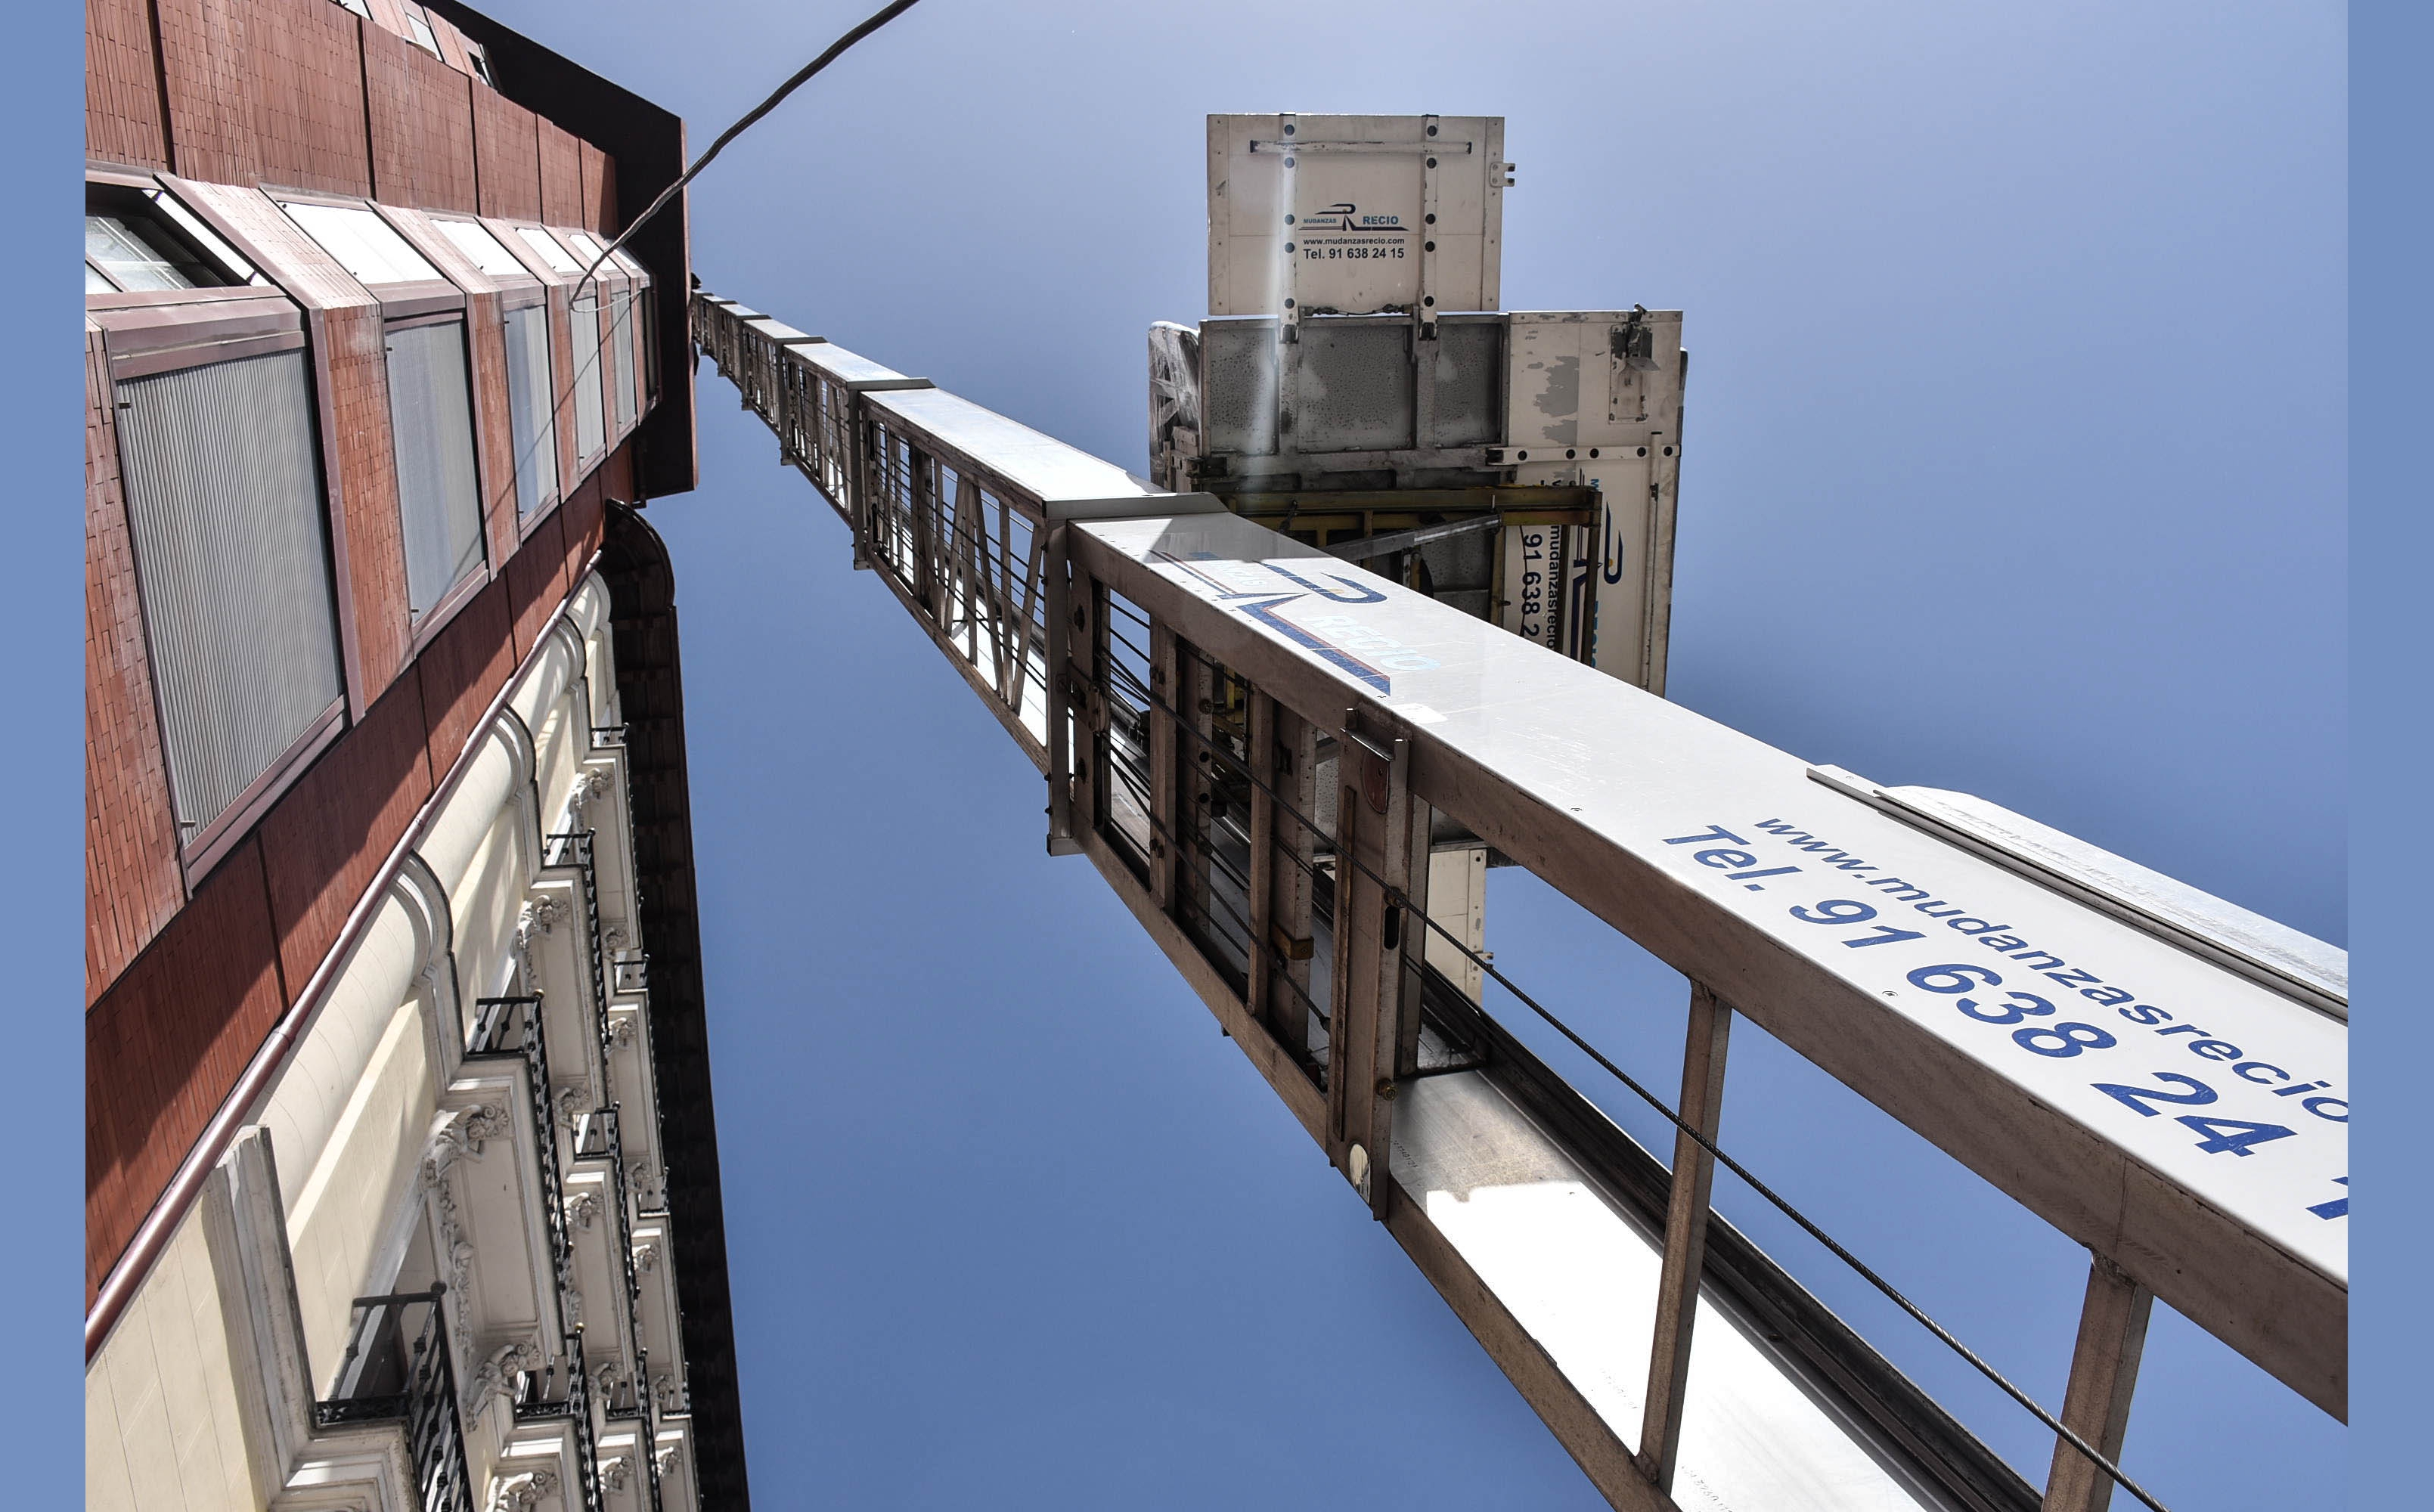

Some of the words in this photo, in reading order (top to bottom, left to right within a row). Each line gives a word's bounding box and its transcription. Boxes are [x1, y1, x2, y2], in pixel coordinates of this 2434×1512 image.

[1363, 215, 1399, 225] RECIO
[1303, 237, 1405, 246] www.mudanzasrecio.com
[1303, 249, 1325, 259] Tel.
[1329, 248, 1342, 259] 91
[1347, 248, 1369, 259] 638
[1372, 248, 1387, 259] 24
[1390, 247, 1404, 259] 15
[1524, 534, 1543, 560] 91
[1521, 572, 1542, 615] 638
[1521, 624, 1540, 637] 2
[1662, 824, 1803, 892] Tel.
[1788, 898, 1926, 950] 91
[1905, 962, 2117, 1059] 638
[2091, 1071, 2297, 1158] 24
